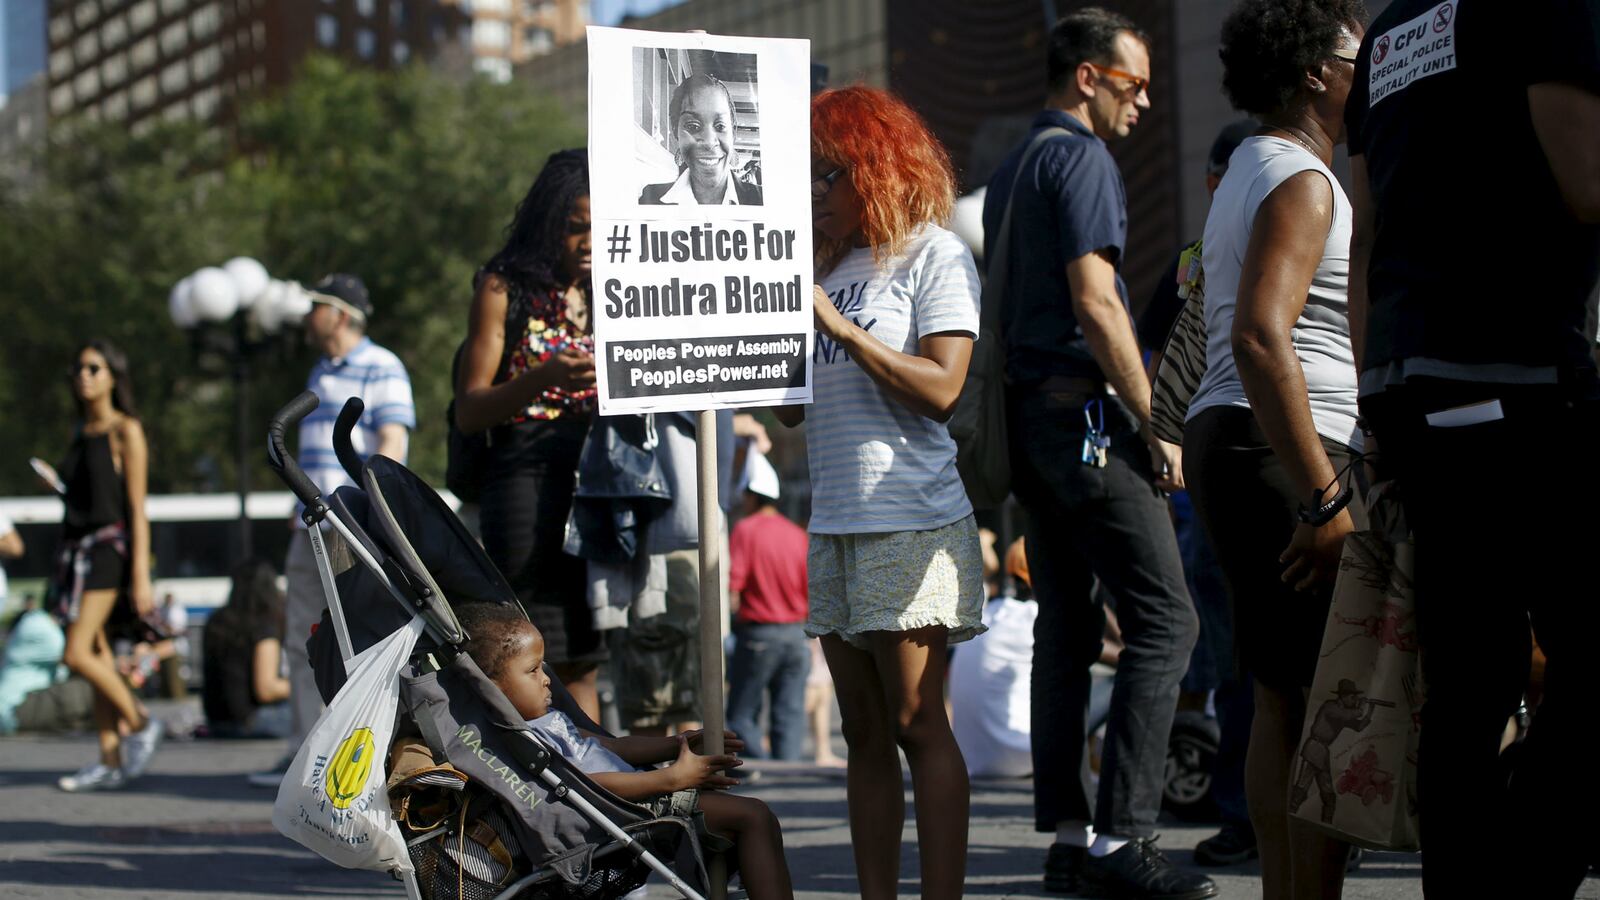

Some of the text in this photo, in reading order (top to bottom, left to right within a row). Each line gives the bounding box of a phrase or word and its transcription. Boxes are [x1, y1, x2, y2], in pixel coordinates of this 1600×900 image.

[1394, 22, 1428, 51] CPU
[1370, 54, 1454, 104] BRUTALITY UNIT
[1371, 35, 1452, 84] SPECIAL POLICE
[639, 222, 748, 263] Justice
[753, 222, 796, 261] For
[604, 274, 802, 319] Sandra Bland
[828, 281, 868, 315] AIL
[613, 338, 801, 364] Peoples Power Assembly
[630, 360, 788, 388] PeoplesPower.net
[312, 754, 328, 795] Have
[455, 725, 542, 810] MACLAREN
